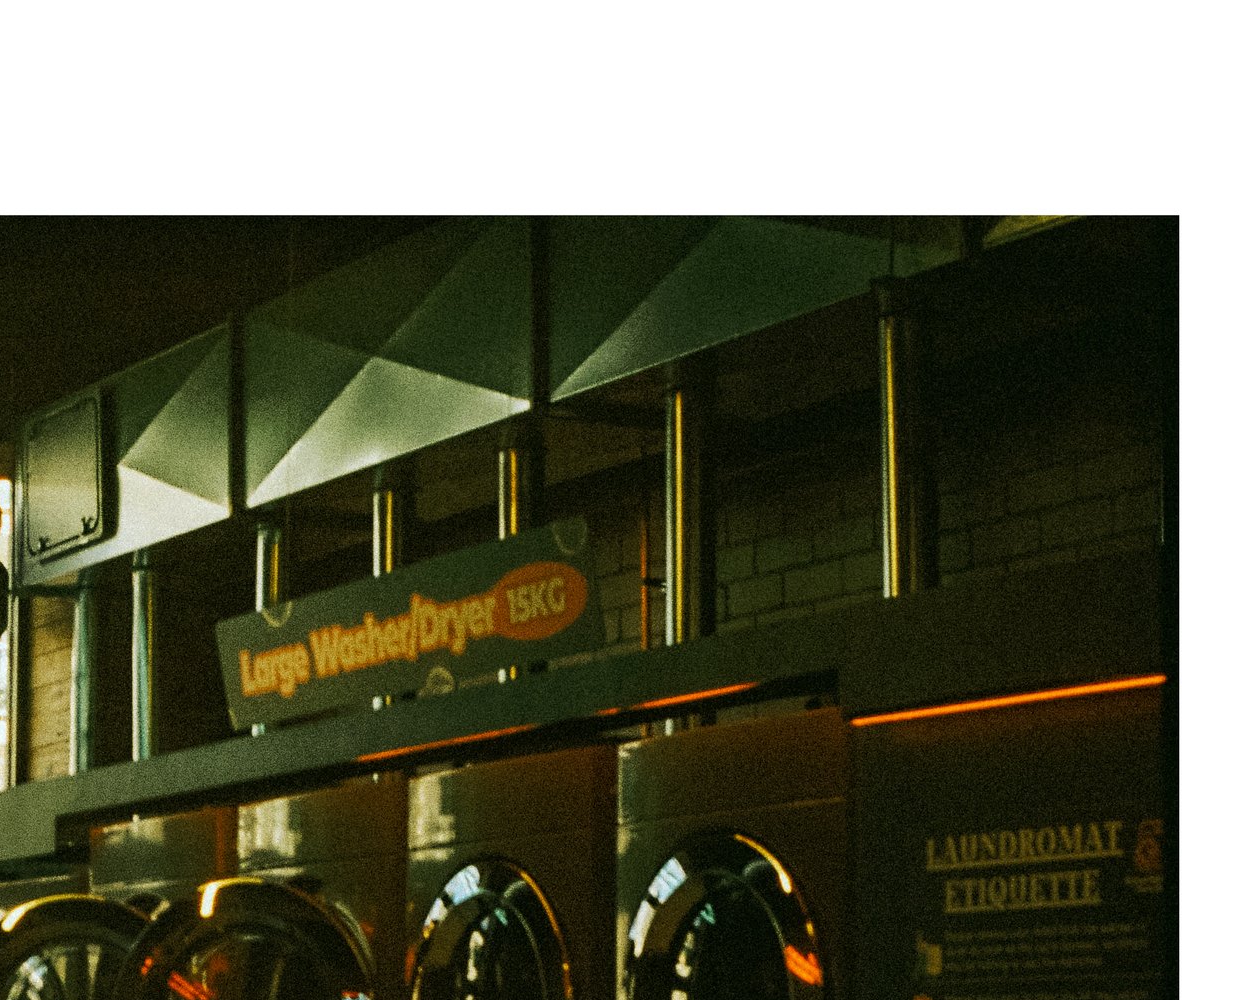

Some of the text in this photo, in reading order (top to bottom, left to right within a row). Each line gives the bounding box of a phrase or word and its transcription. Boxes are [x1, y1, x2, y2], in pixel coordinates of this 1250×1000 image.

[240, 576, 567, 699] Large Washer/Dryer 15KG
[926, 820, 1123, 867] LAUNDROMAT
[944, 869, 1101, 910] ETIQUETTE
